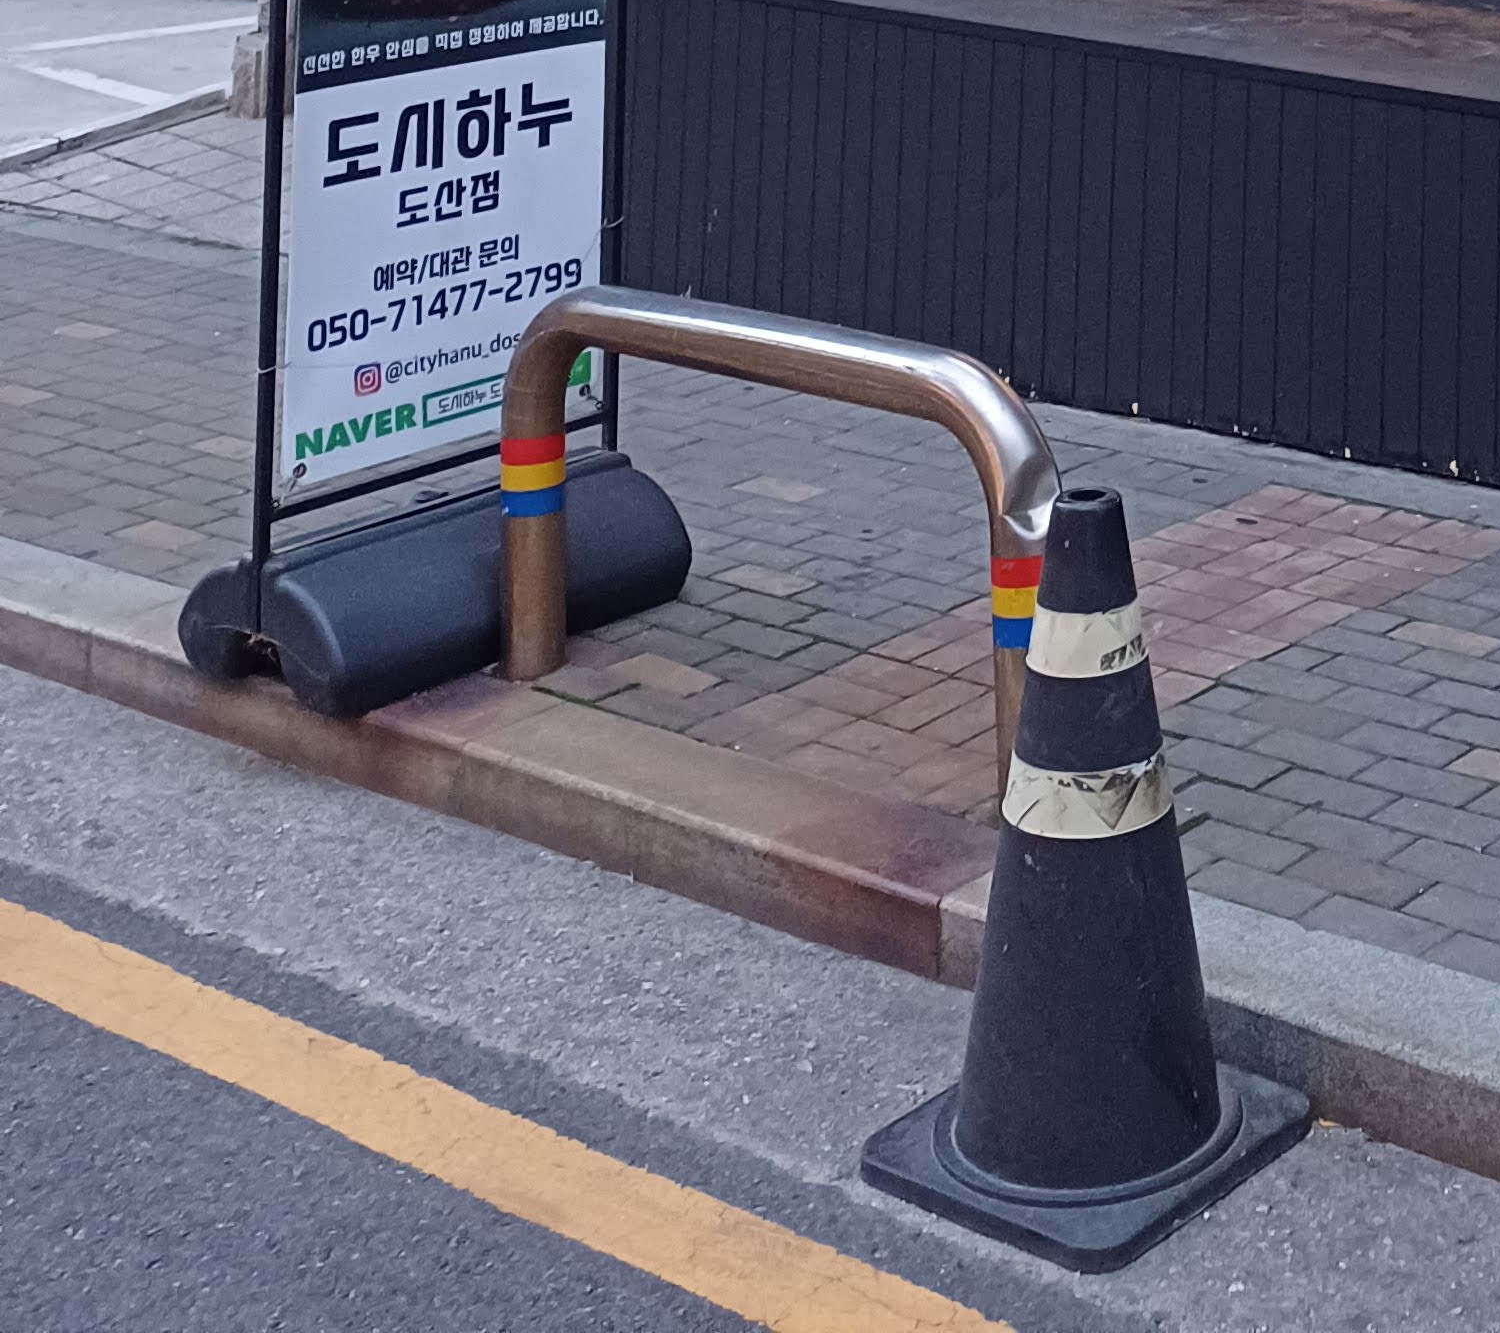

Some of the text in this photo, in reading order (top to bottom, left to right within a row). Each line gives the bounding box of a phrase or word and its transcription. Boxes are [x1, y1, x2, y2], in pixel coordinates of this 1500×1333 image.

[303, 49, 346, 75] 신선한
[351, 44, 381, 66] 한우
[435, 30, 463, 51] 직접
[322, 81, 574, 189] 도시하누
[395, 170, 501, 230] 도산점
[373, 233, 520, 292] 예약/대관 문의
[306, 257, 582, 353] 050-71477-2799
[385, 332, 521, 385] @cityhanu_dos
[437, 382, 503, 415] 도시하누 도
[295, 403, 417, 461] NAVER
